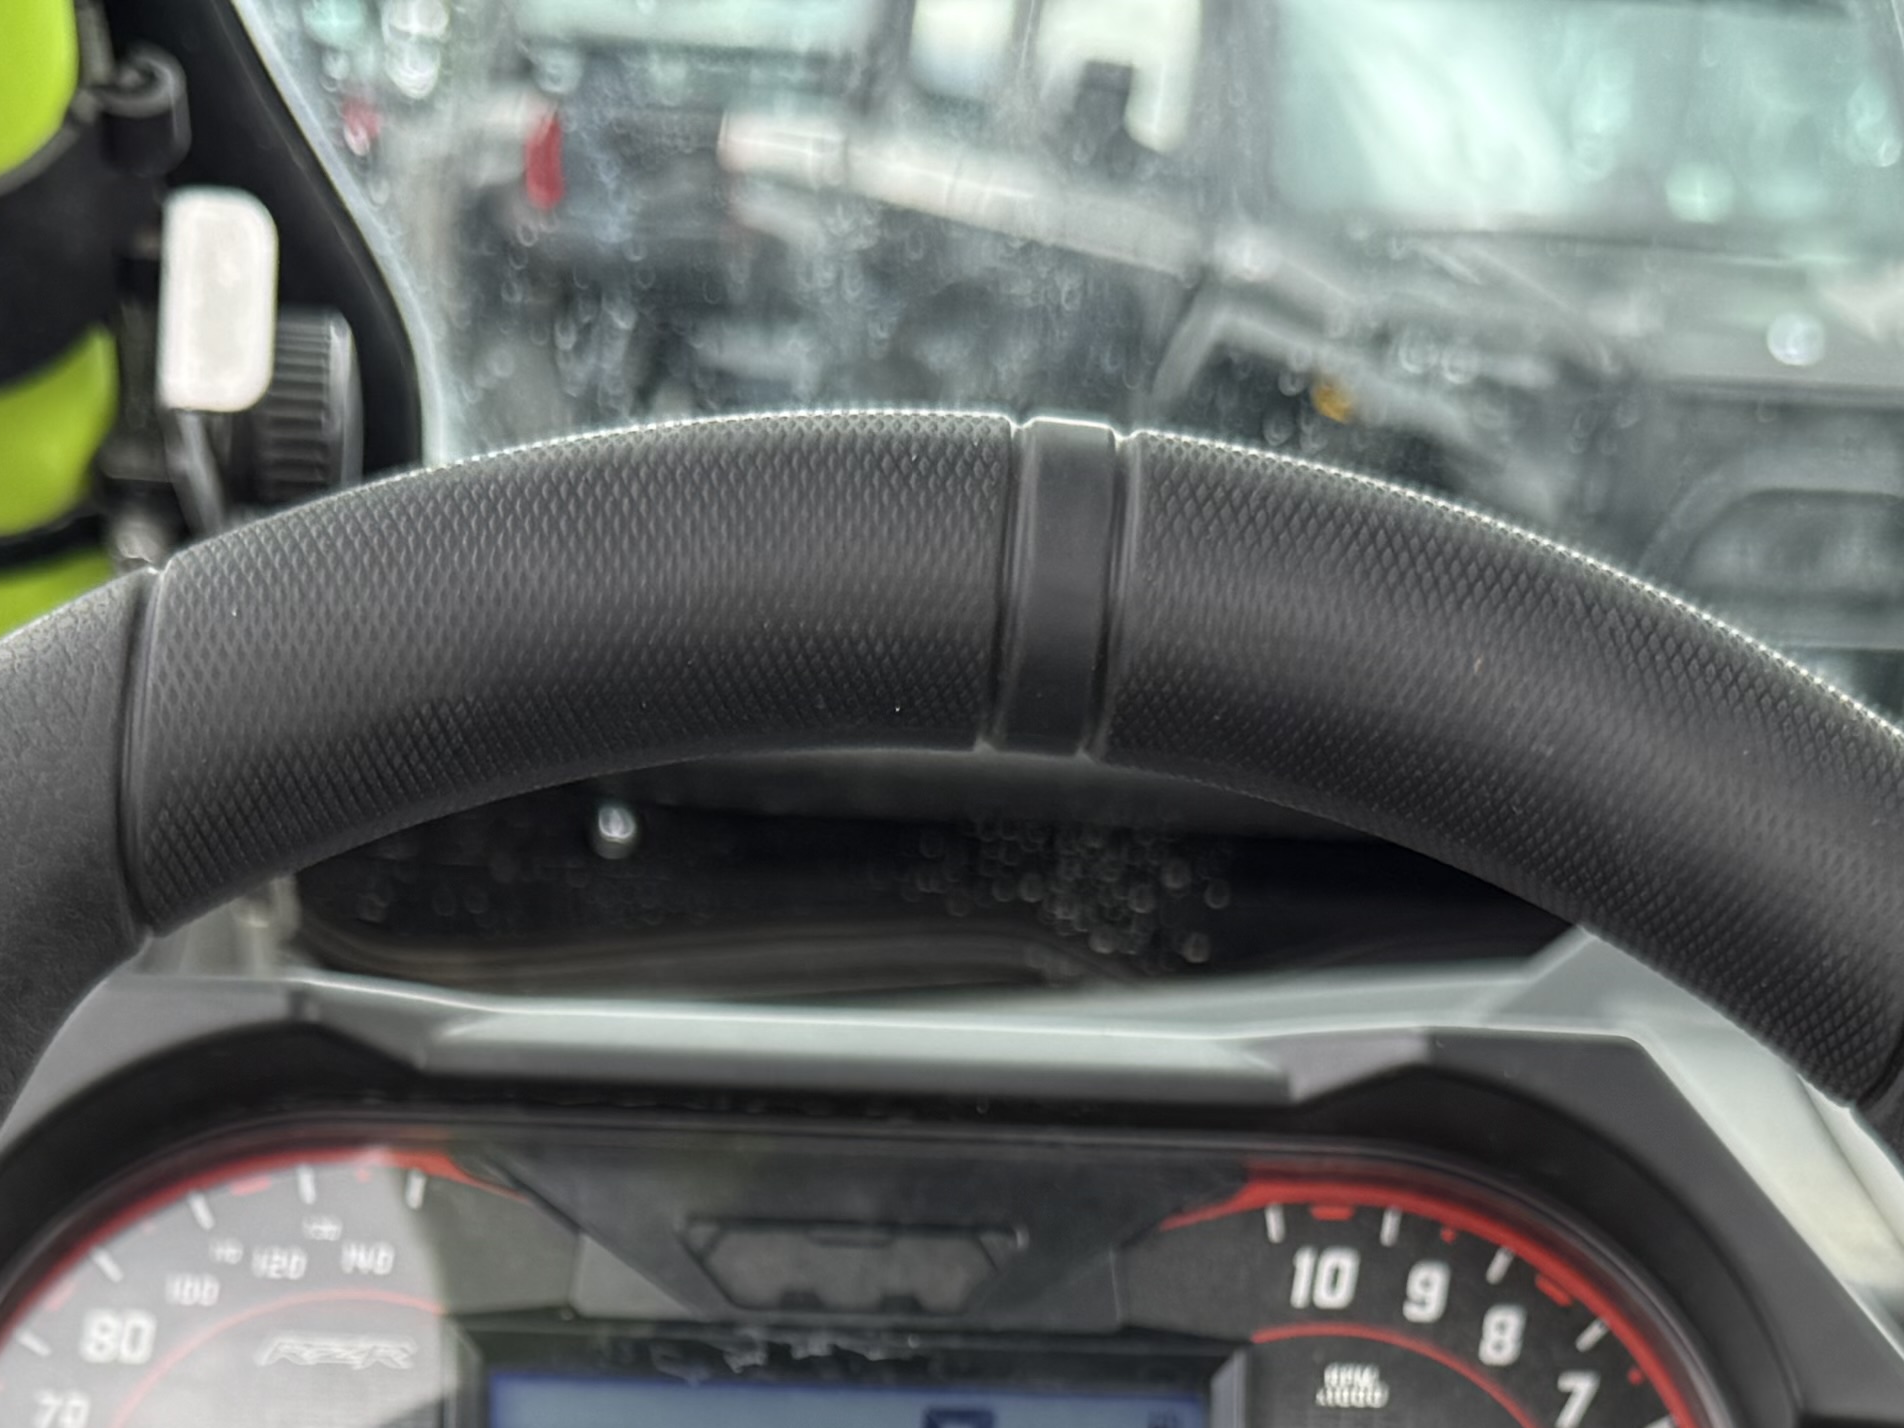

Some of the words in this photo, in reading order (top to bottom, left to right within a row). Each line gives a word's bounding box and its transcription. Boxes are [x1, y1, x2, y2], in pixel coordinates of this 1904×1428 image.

[251, 1245, 308, 1280] 120
[341, 1239, 395, 1276] 140
[1291, 1247, 1361, 1310] 10
[166, 1274, 219, 1307] 100
[1403, 1261, 1451, 1323] 9
[77, 1309, 157, 1366] 80
[1479, 1306, 1525, 1367] 8
